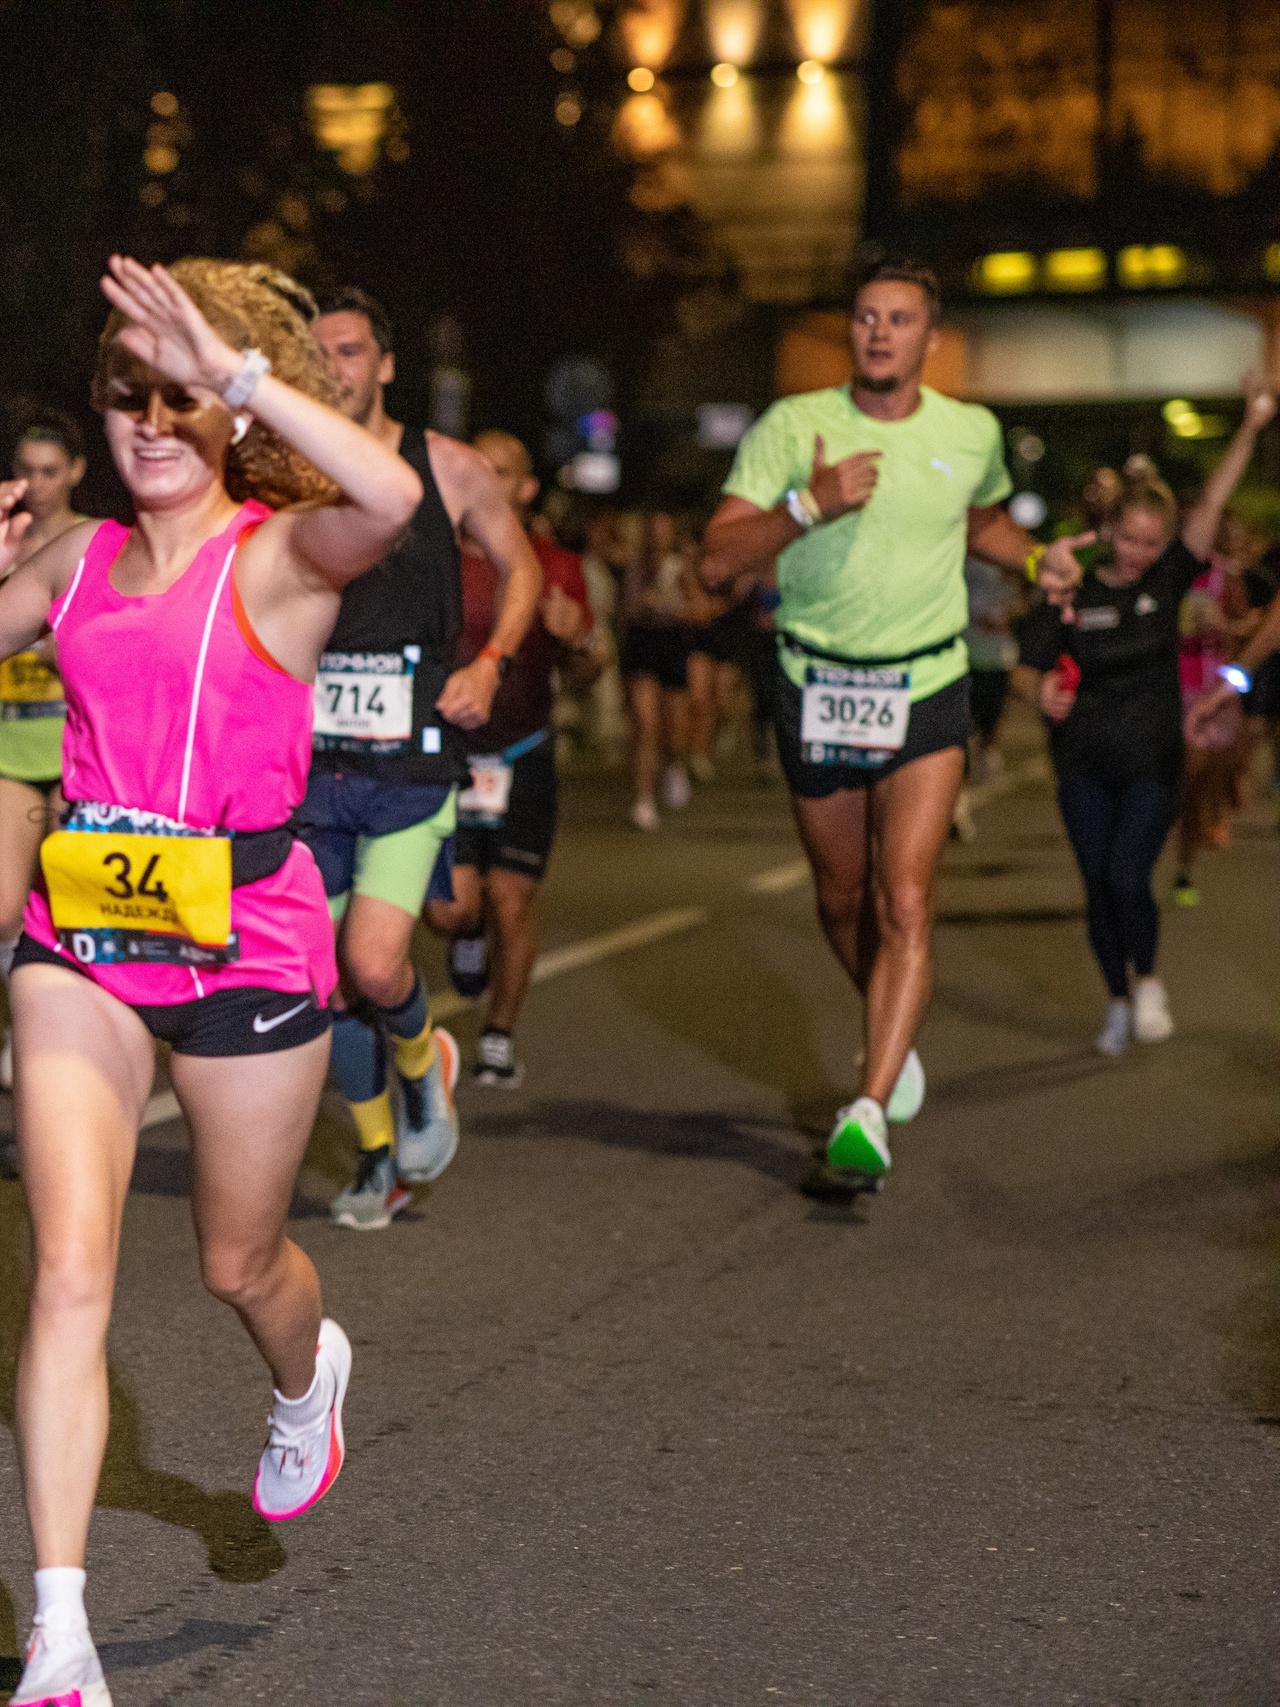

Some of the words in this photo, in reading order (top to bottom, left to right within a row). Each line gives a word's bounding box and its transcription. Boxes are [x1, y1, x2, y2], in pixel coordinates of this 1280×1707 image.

[326, 683, 385, 716] 714
[819, 693, 894, 728] 3026
[102, 851, 169, 904] 34
[72, 932, 96, 964] D
